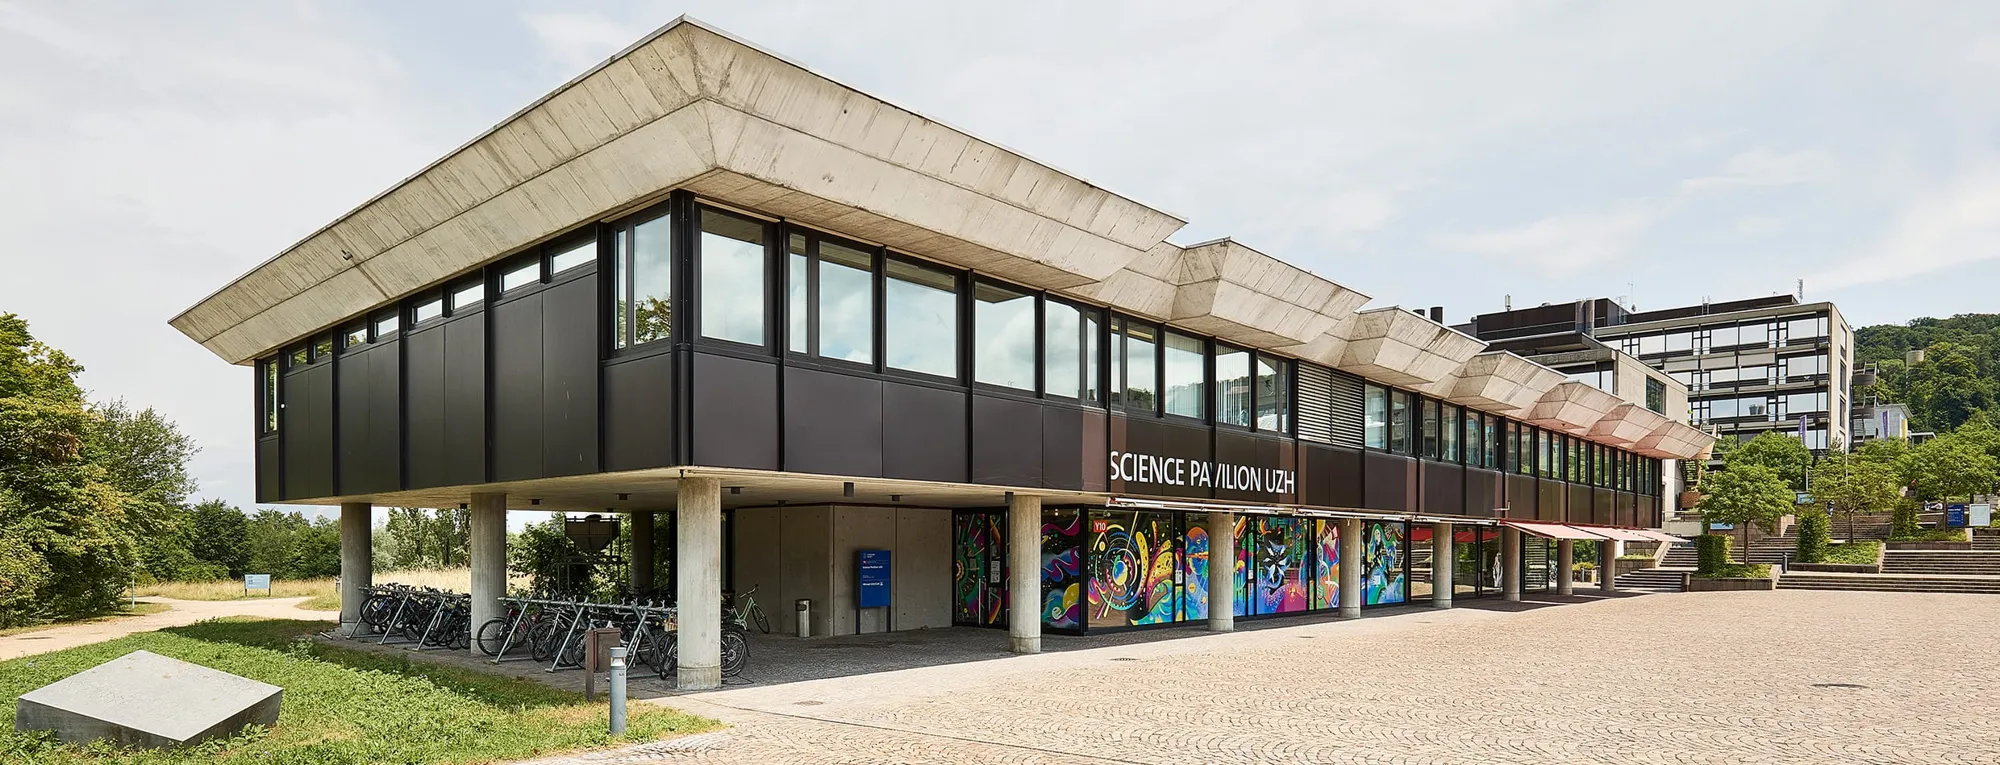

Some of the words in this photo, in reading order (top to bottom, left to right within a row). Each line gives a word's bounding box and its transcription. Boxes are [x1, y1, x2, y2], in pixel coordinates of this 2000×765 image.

[1110, 451, 1185, 486] SCIENCE
[1265, 468, 1295, 494] UZH
[1095, 522, 1106, 531] Y10
